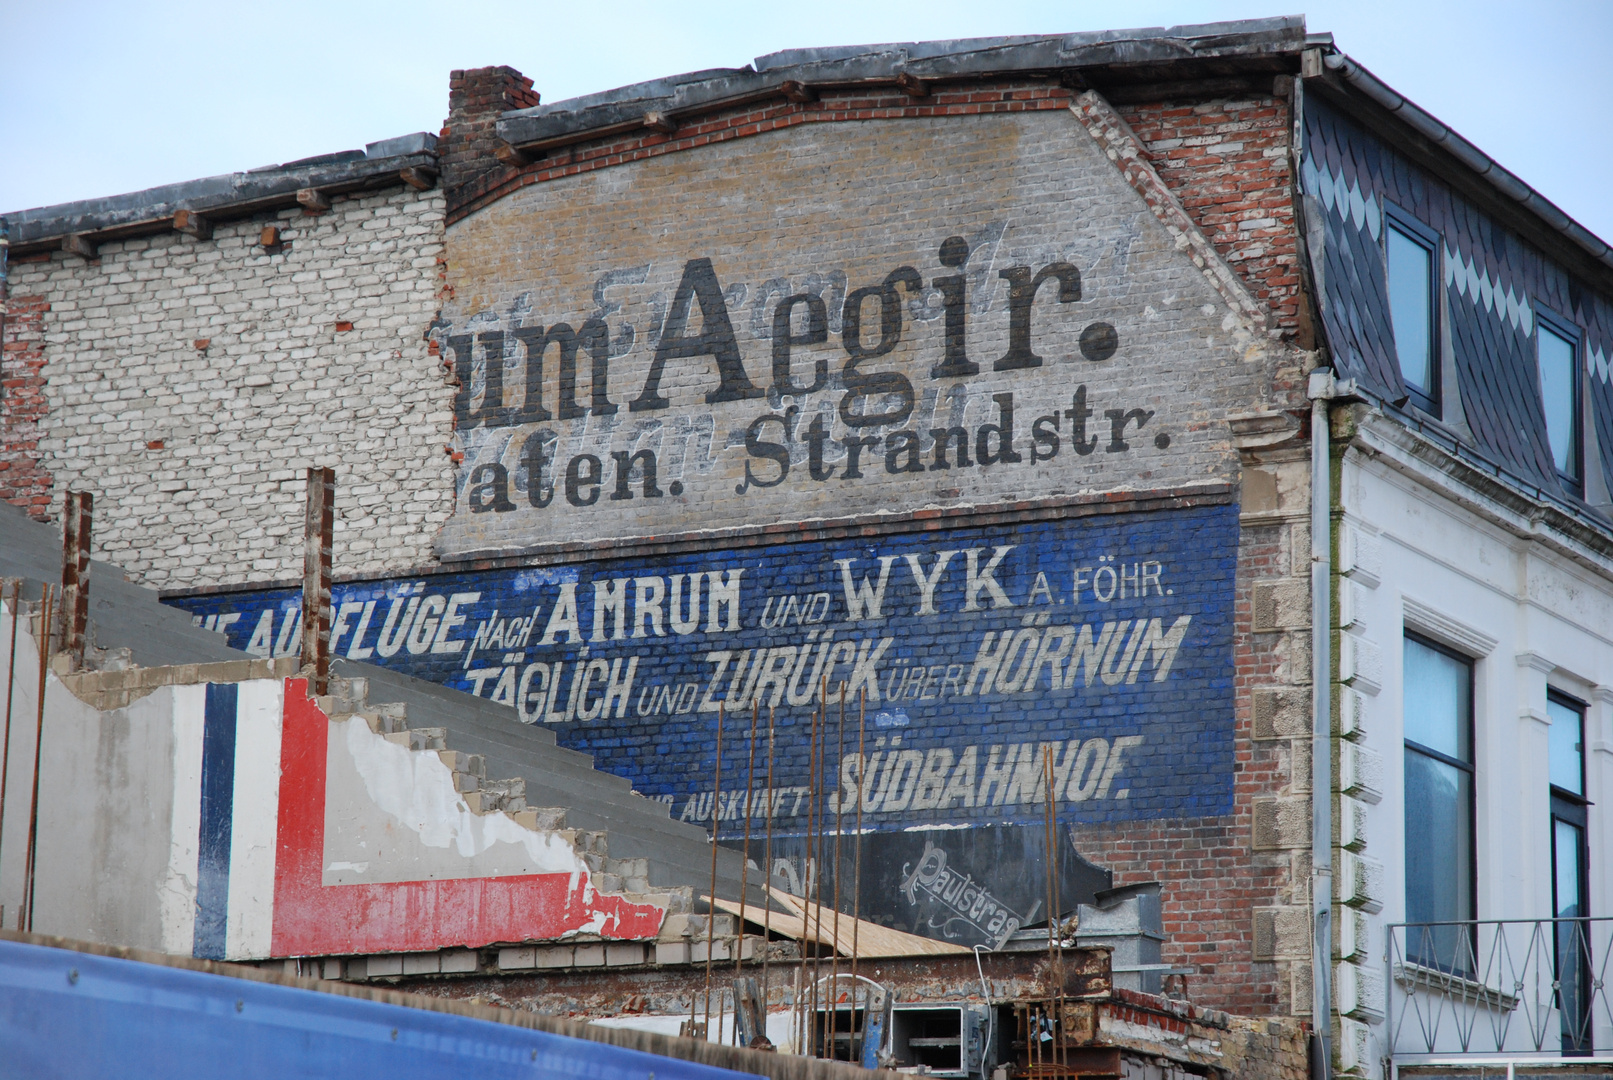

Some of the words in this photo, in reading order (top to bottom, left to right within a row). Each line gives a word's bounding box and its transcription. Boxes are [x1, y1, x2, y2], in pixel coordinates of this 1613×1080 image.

[628, 235, 1119, 428] Aegir.
[469, 426, 684, 514] aten.
[735, 384, 1171, 494] Strandstr.
[245, 581, 481, 659] AUFLÜGE
[463, 605, 541, 669] NACH
[537, 568, 746, 645] AMRUM
[760, 592, 830, 629] UND
[833, 545, 1017, 622] WYK
[1027, 571, 1065, 606] A.
[1072, 555, 1174, 605] FÖHR.
[636, 682, 699, 717] UND
[696, 629, 894, 713] ZURÜCK
[885, 658, 965, 702] ÜBER
[962, 610, 1192, 696] HÖRNUM
[680, 786, 814, 822] AUSKUNFT
[829, 735, 1145, 814] SÜDBAHNHOF.
